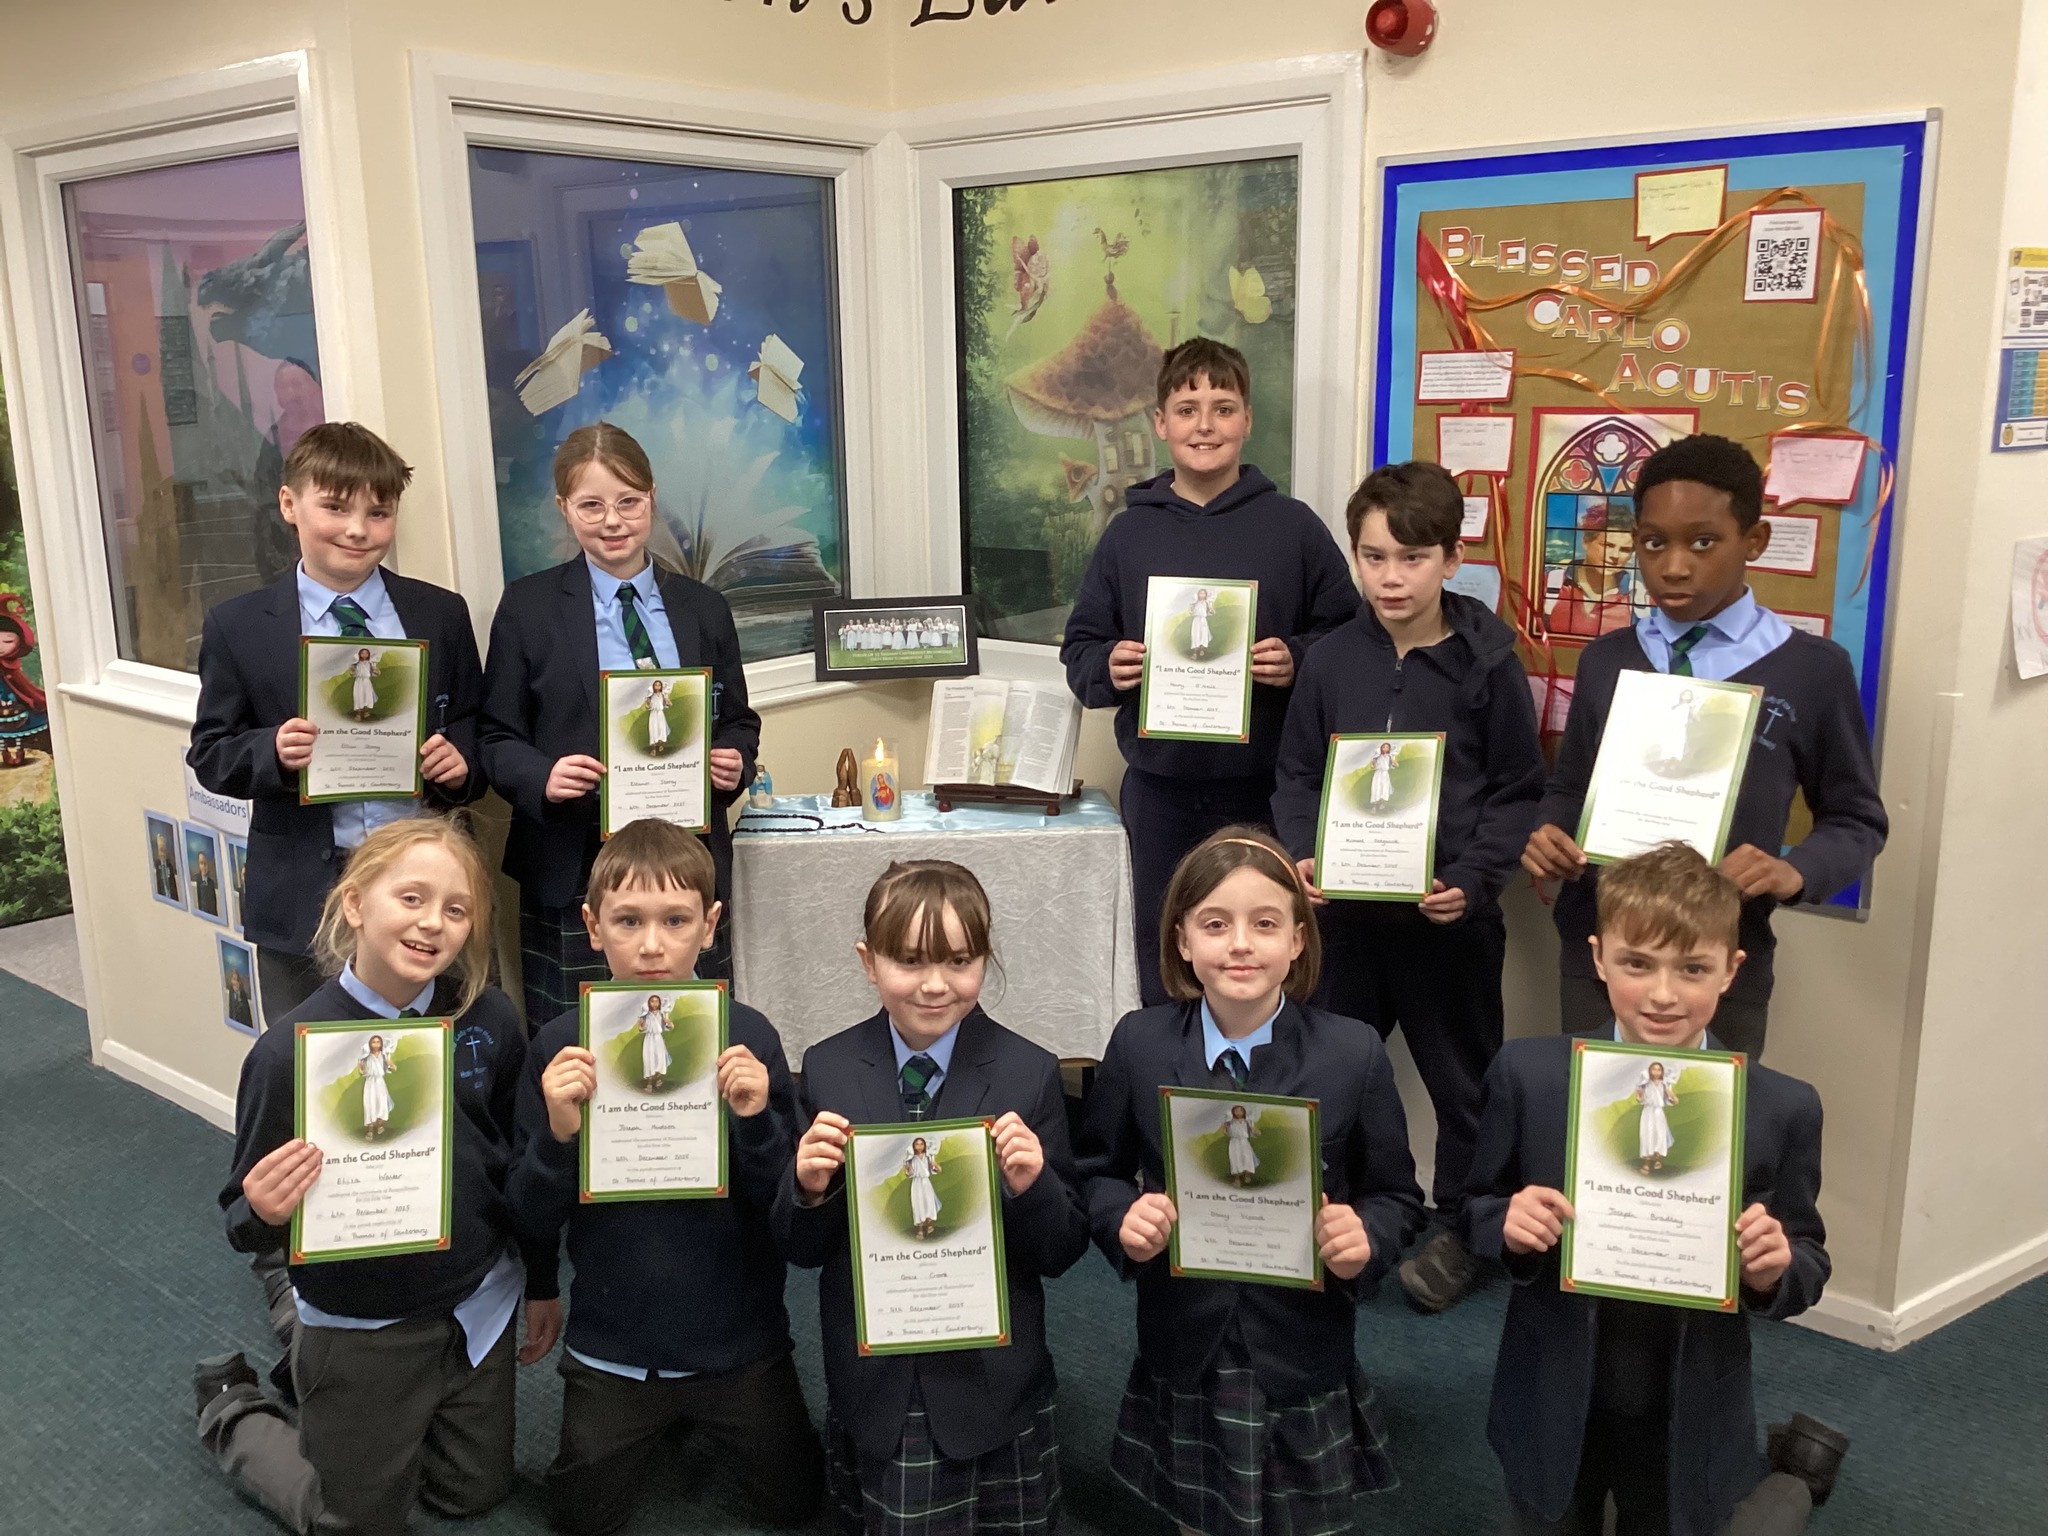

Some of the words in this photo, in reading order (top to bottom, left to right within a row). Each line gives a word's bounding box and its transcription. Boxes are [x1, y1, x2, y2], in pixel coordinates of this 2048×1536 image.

[1440, 225, 1661, 294] BLESSED
[1526, 291, 1690, 353] CARLO
[1606, 354, 1811, 418] ACUTIS
[1207, 668, 1241, 676] Shepherd"
[350, 728, 371, 736] Good
[647, 763, 666, 771] Good
[667, 761, 700, 770] Shepherd"
[190, 785, 247, 818] Ambassadors
[1365, 821, 1385, 829] Good
[1386, 821, 1424, 829] Shepherd"
[624, 1103, 638, 1112] the
[640, 1102, 665, 1111] Good
[667, 1102, 712, 1111] Shepherd"
[343, 1154, 358, 1163] the
[360, 1152, 386, 1162] Good
[389, 1147, 436, 1160] Shepherd"
[1212, 1193, 1226, 1201] the
[1229, 1194, 1254, 1204] Good
[1597, 1184, 1613, 1193] am
[1615, 1184, 1632, 1195] the
[1634, 1186, 1663, 1199] Good
[1667, 1190, 1721, 1205] Shepherd"
[896, 1251, 910, 1261] the
[912, 1250, 938, 1260] Good
[941, 1246, 987, 1258] Shepherd"
[1663, 1277, 1712, 1293] Canterbury
